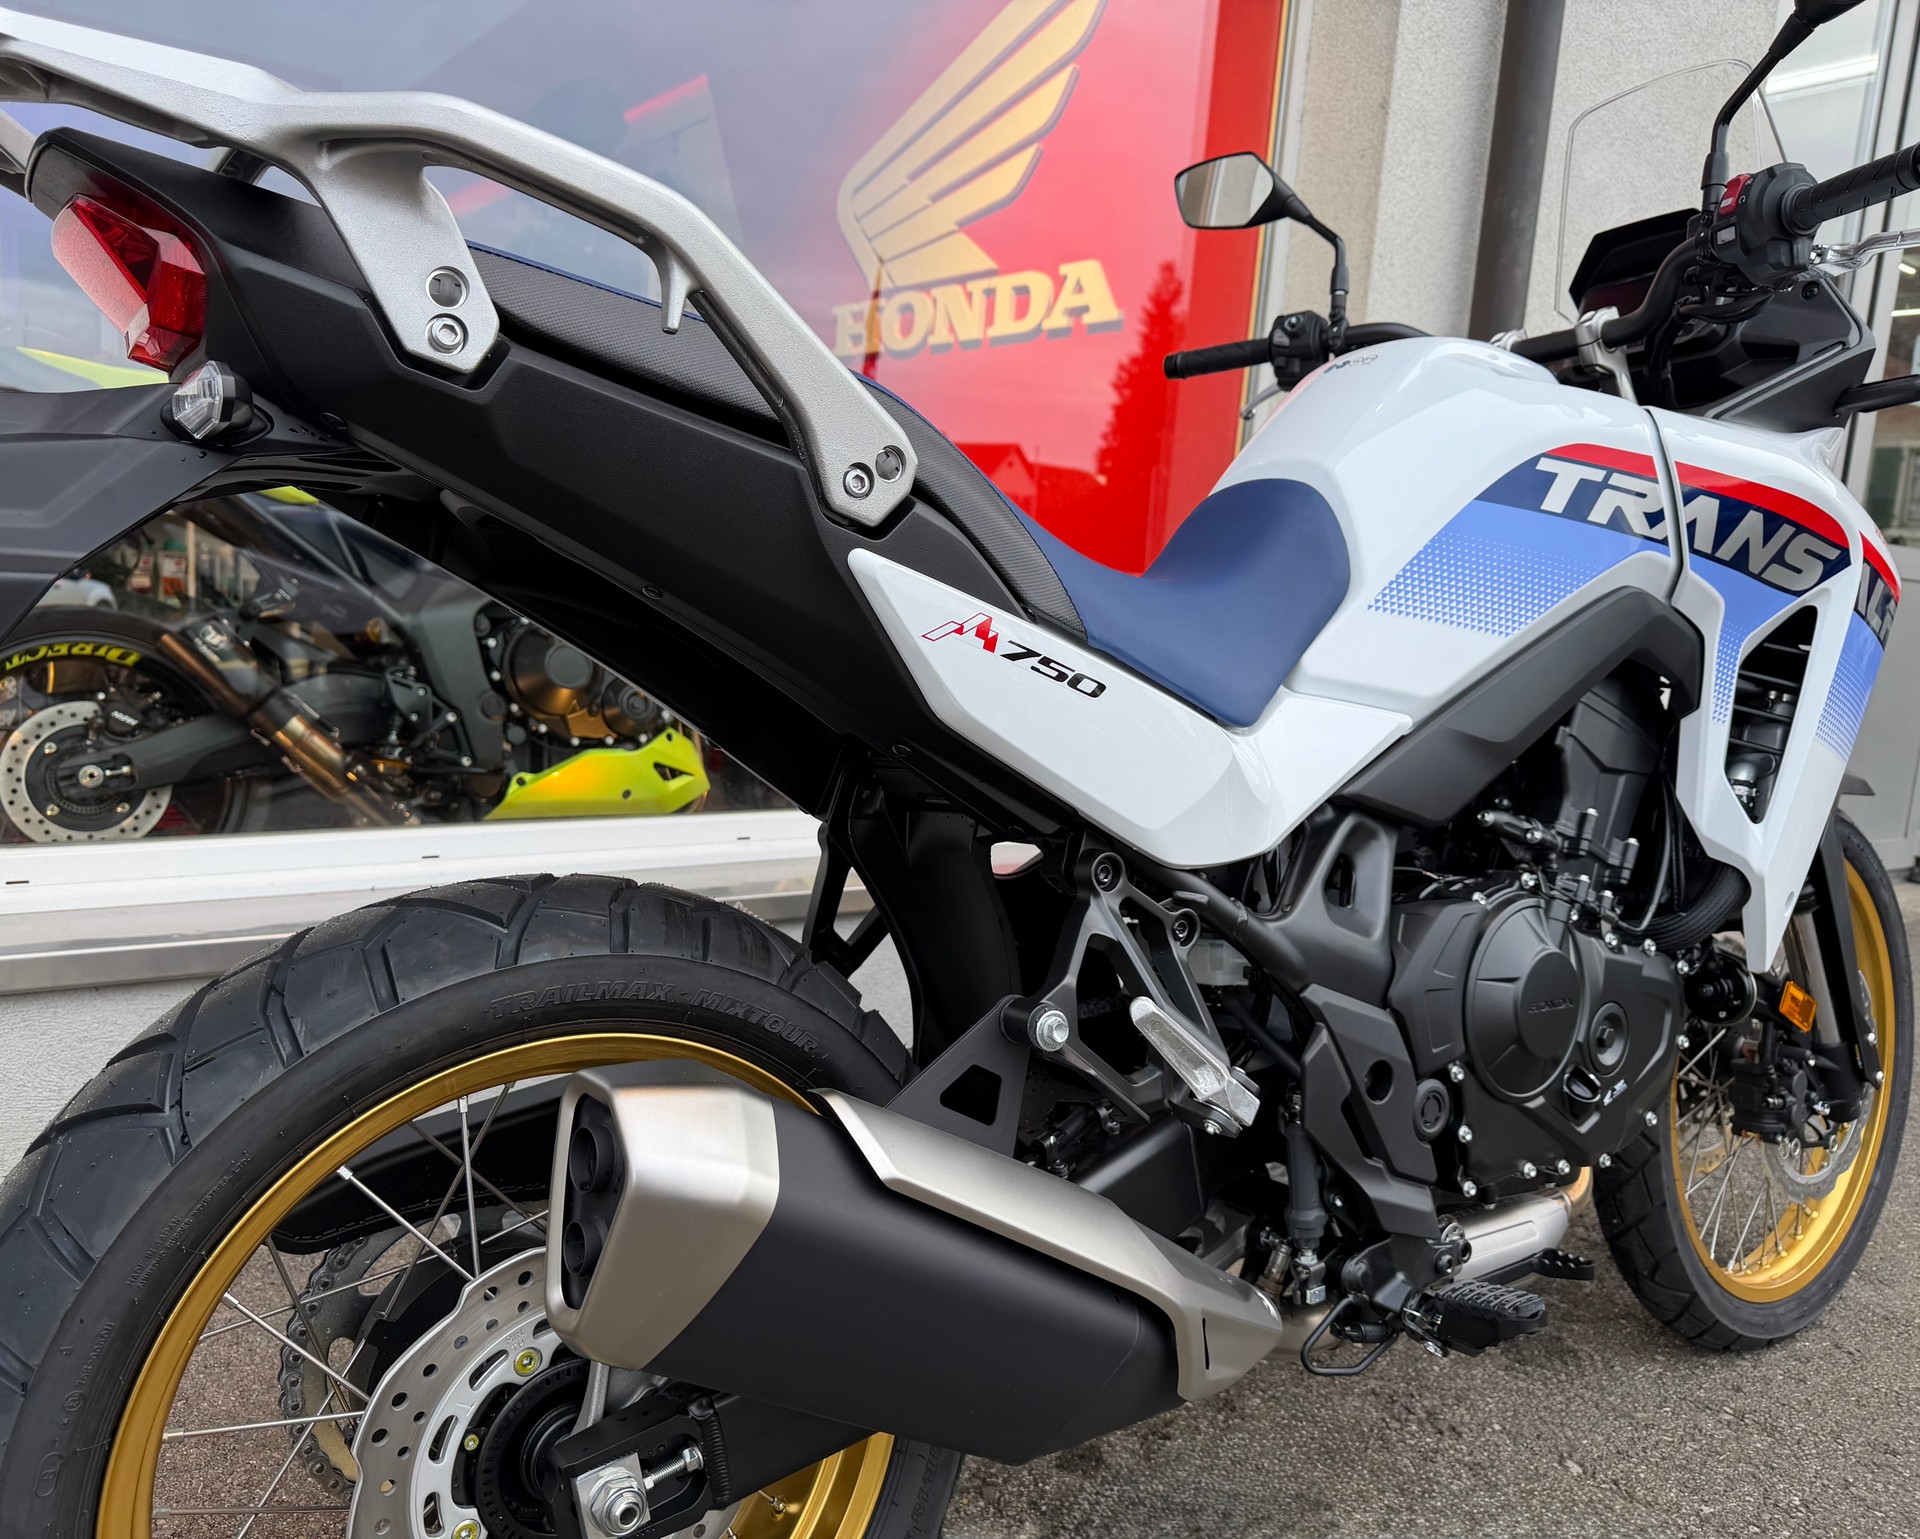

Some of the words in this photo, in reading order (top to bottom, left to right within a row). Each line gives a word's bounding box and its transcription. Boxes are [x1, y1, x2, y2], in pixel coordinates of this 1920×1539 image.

[831, 258, 1123, 359] HONDA
[1000, 640, 1107, 698] 750
[491, 980, 676, 1019] TRAILMAX
[690, 988, 819, 1053] MIXTOUR
